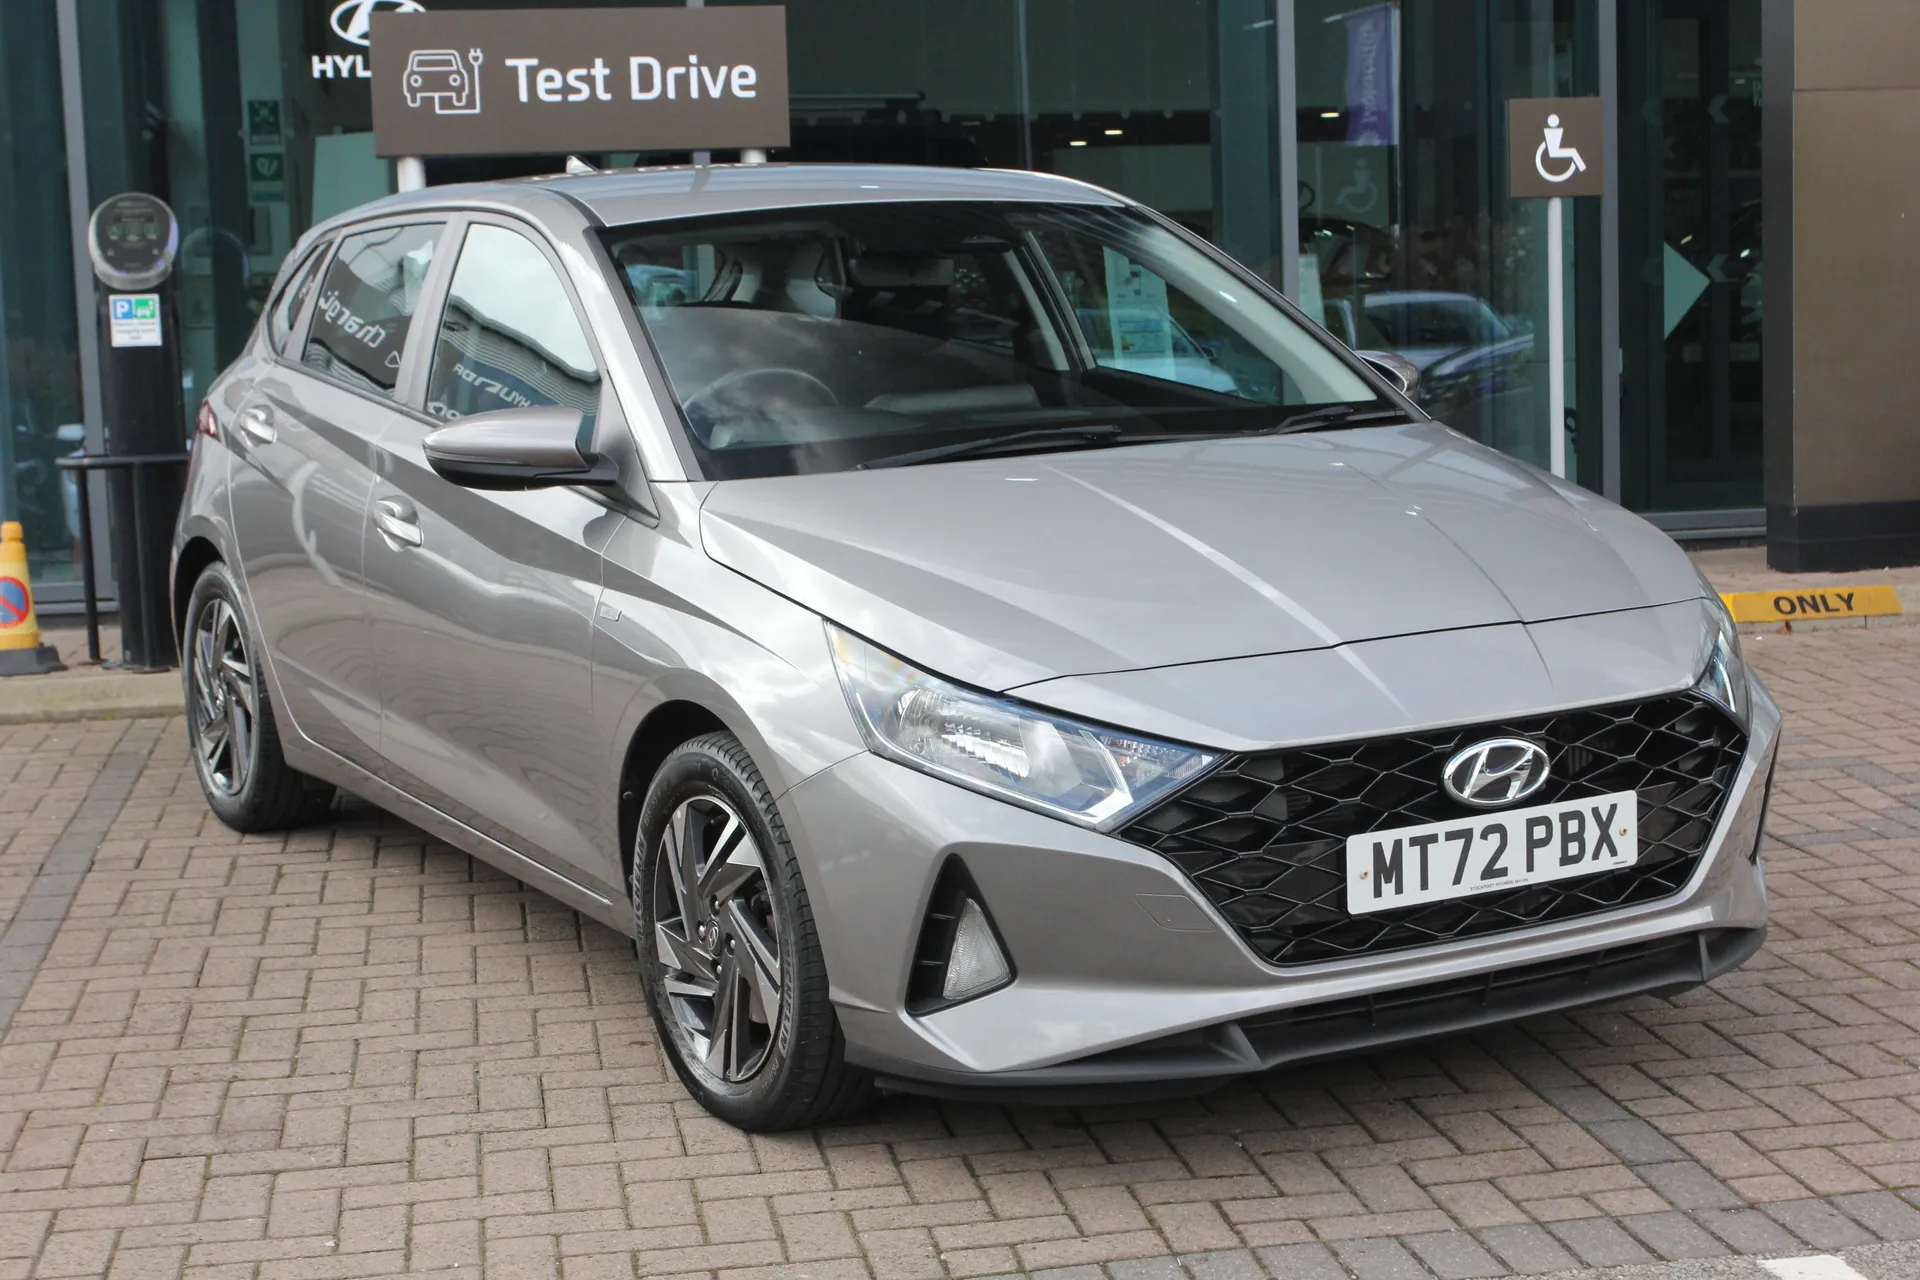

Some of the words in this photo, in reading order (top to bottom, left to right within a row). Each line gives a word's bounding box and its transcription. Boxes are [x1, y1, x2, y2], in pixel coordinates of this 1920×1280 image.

[504, 57, 612, 103] Test
[629, 54, 757, 101] Drive
[116, 301, 129, 318] P
[1773, 592, 1855, 615] ONLY
[1372, 822, 1509, 899] MT72
[1525, 803, 1618, 873] PBX
